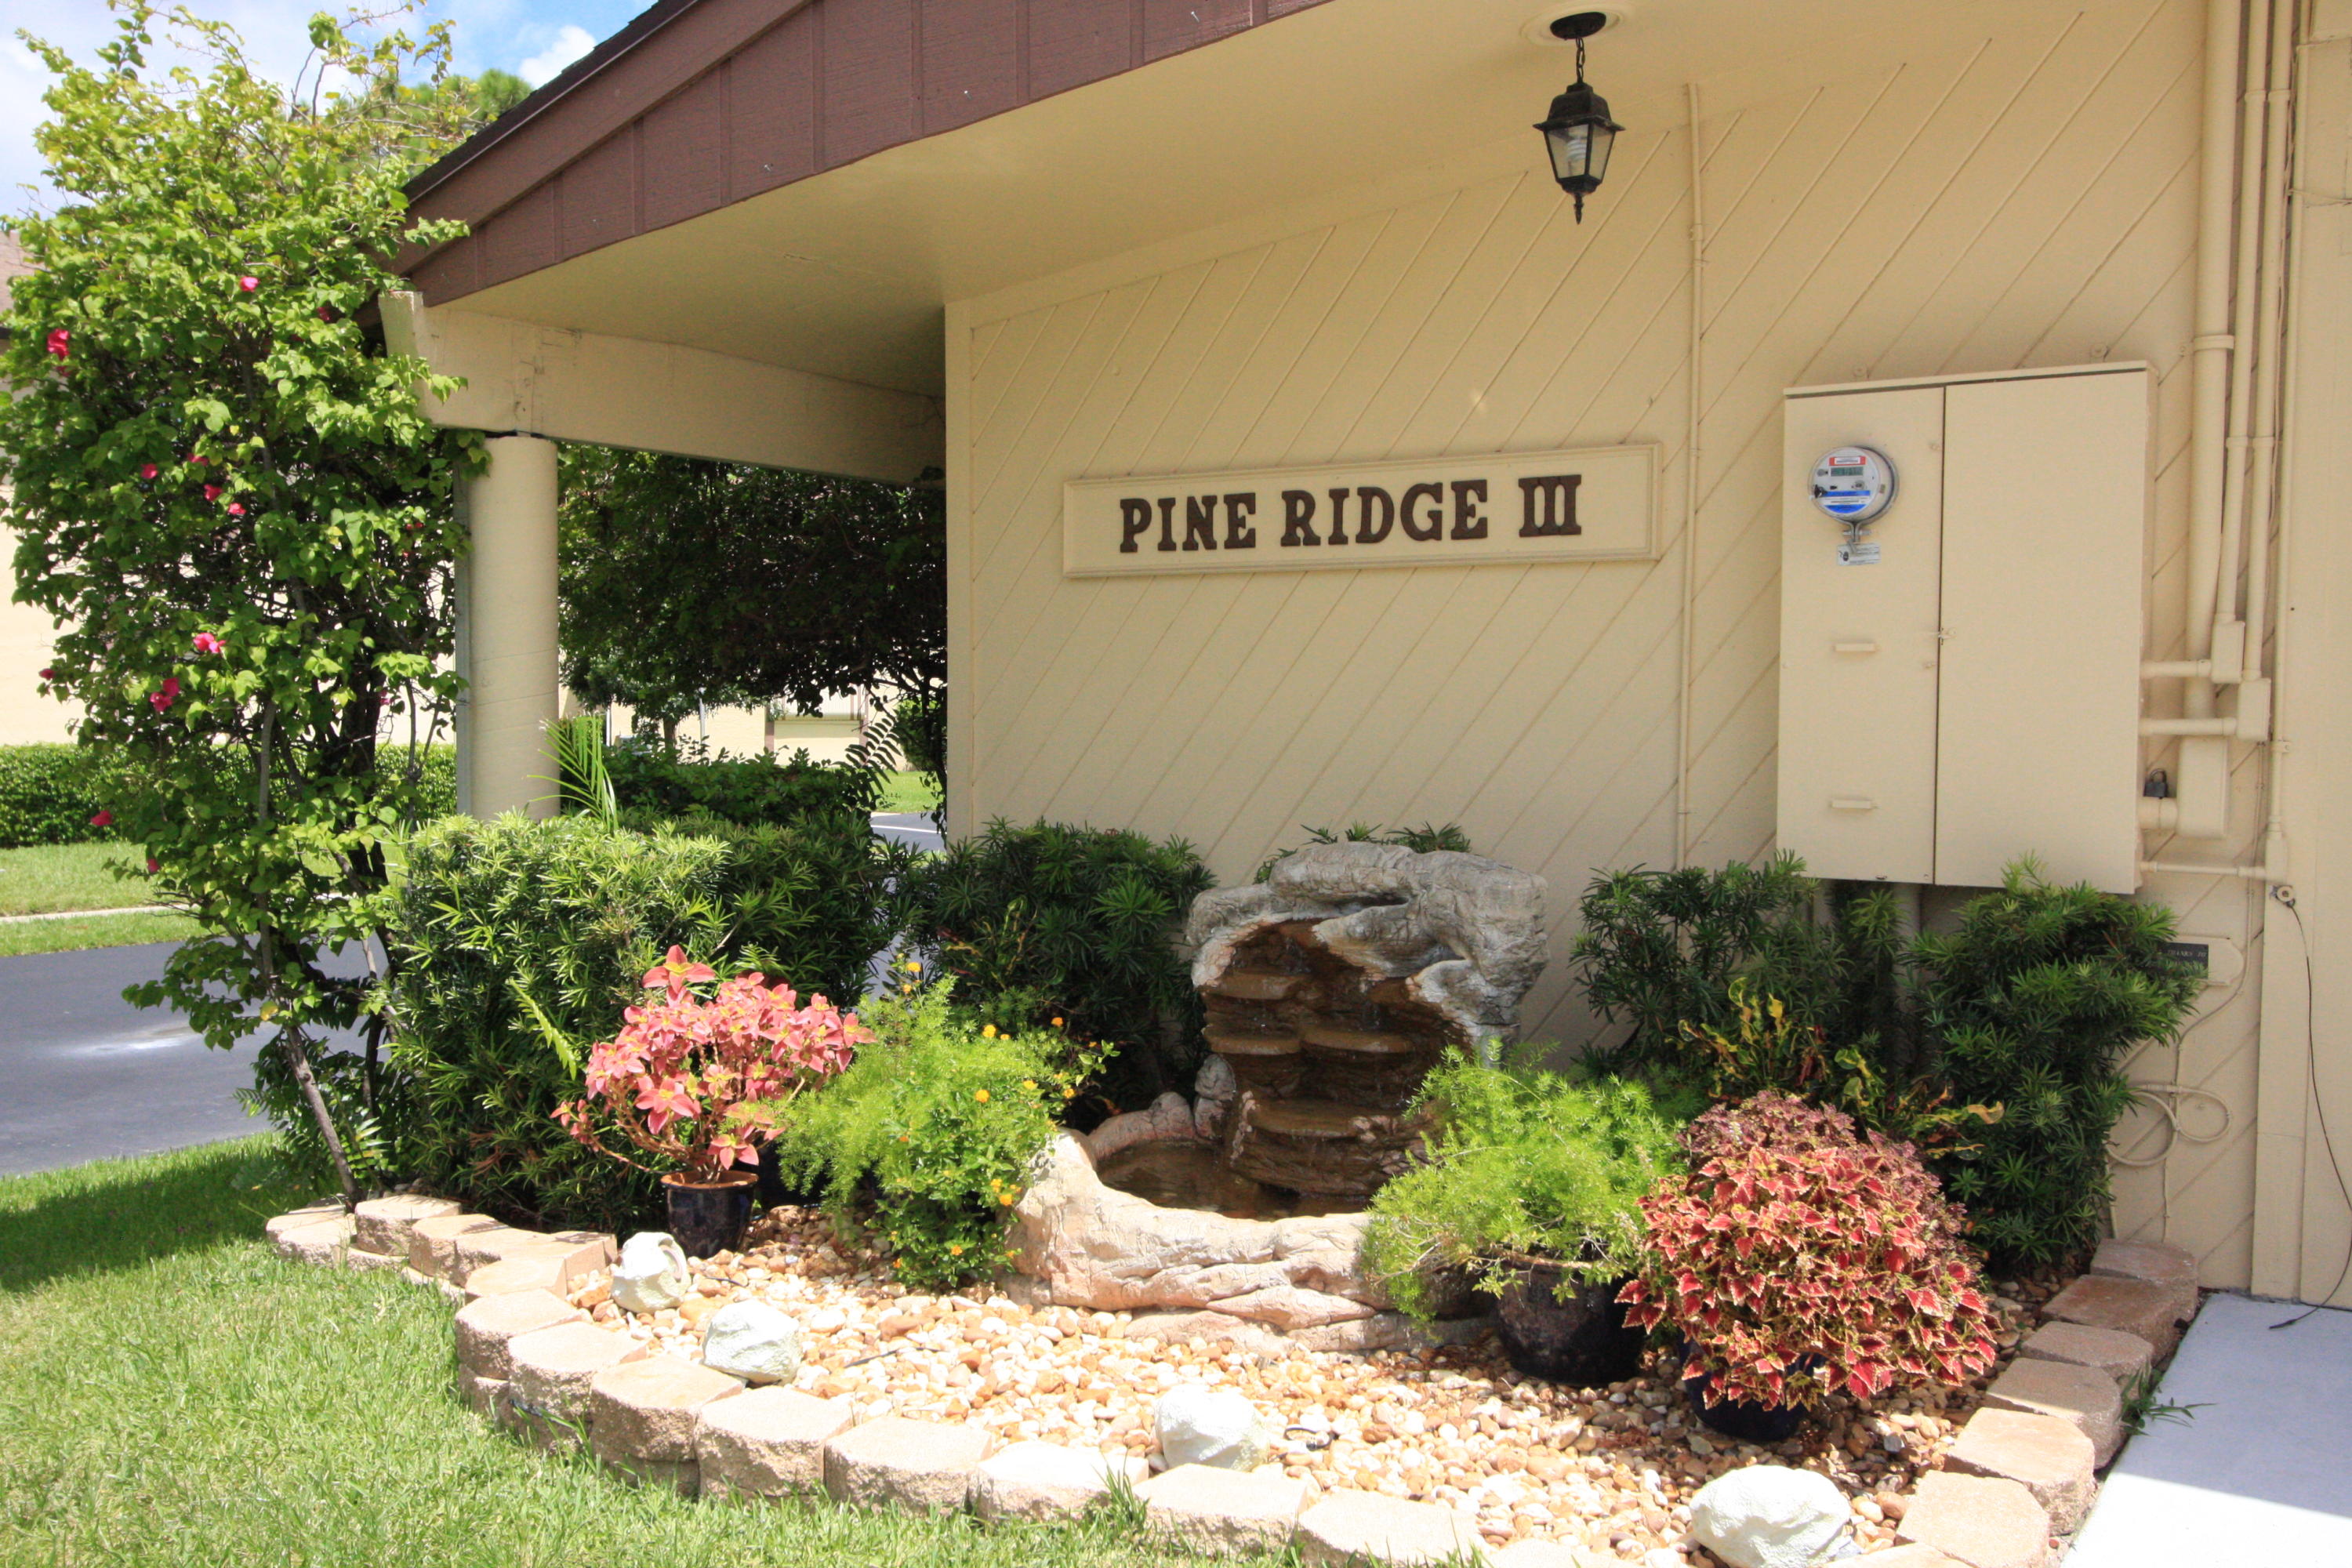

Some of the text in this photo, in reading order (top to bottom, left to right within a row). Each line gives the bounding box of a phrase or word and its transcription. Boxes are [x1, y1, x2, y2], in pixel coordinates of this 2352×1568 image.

[1120, 474, 1582, 553] PINE RIDGE III
